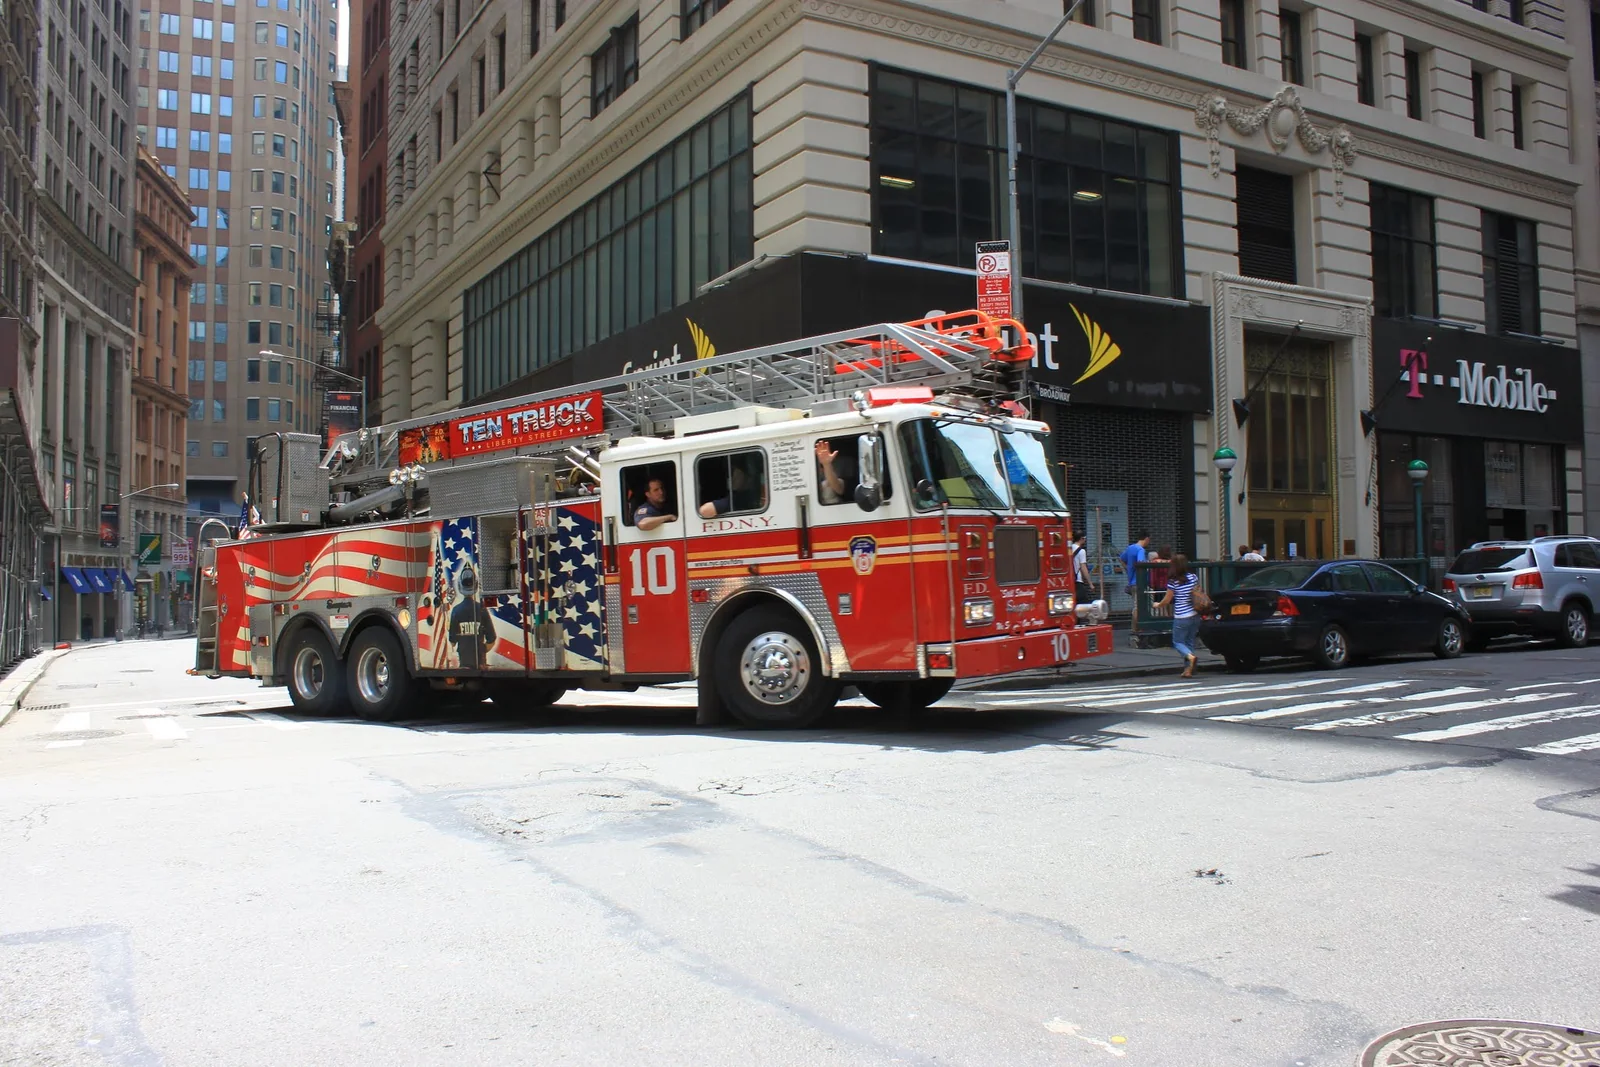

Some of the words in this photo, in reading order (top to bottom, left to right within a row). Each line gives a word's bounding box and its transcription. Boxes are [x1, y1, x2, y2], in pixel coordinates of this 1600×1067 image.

[1040, 387, 1071, 402] BROADWAY
[458, 415, 503, 444] TEN
[507, 397, 594, 435] TRUCK
[486, 437, 524, 448] LIBERTY
[528, 429, 564, 441] STREET
[702, 516, 777, 532] F.D.N.Y.
[629, 546, 676, 597] 10
[1051, 633, 1070, 661] 10
